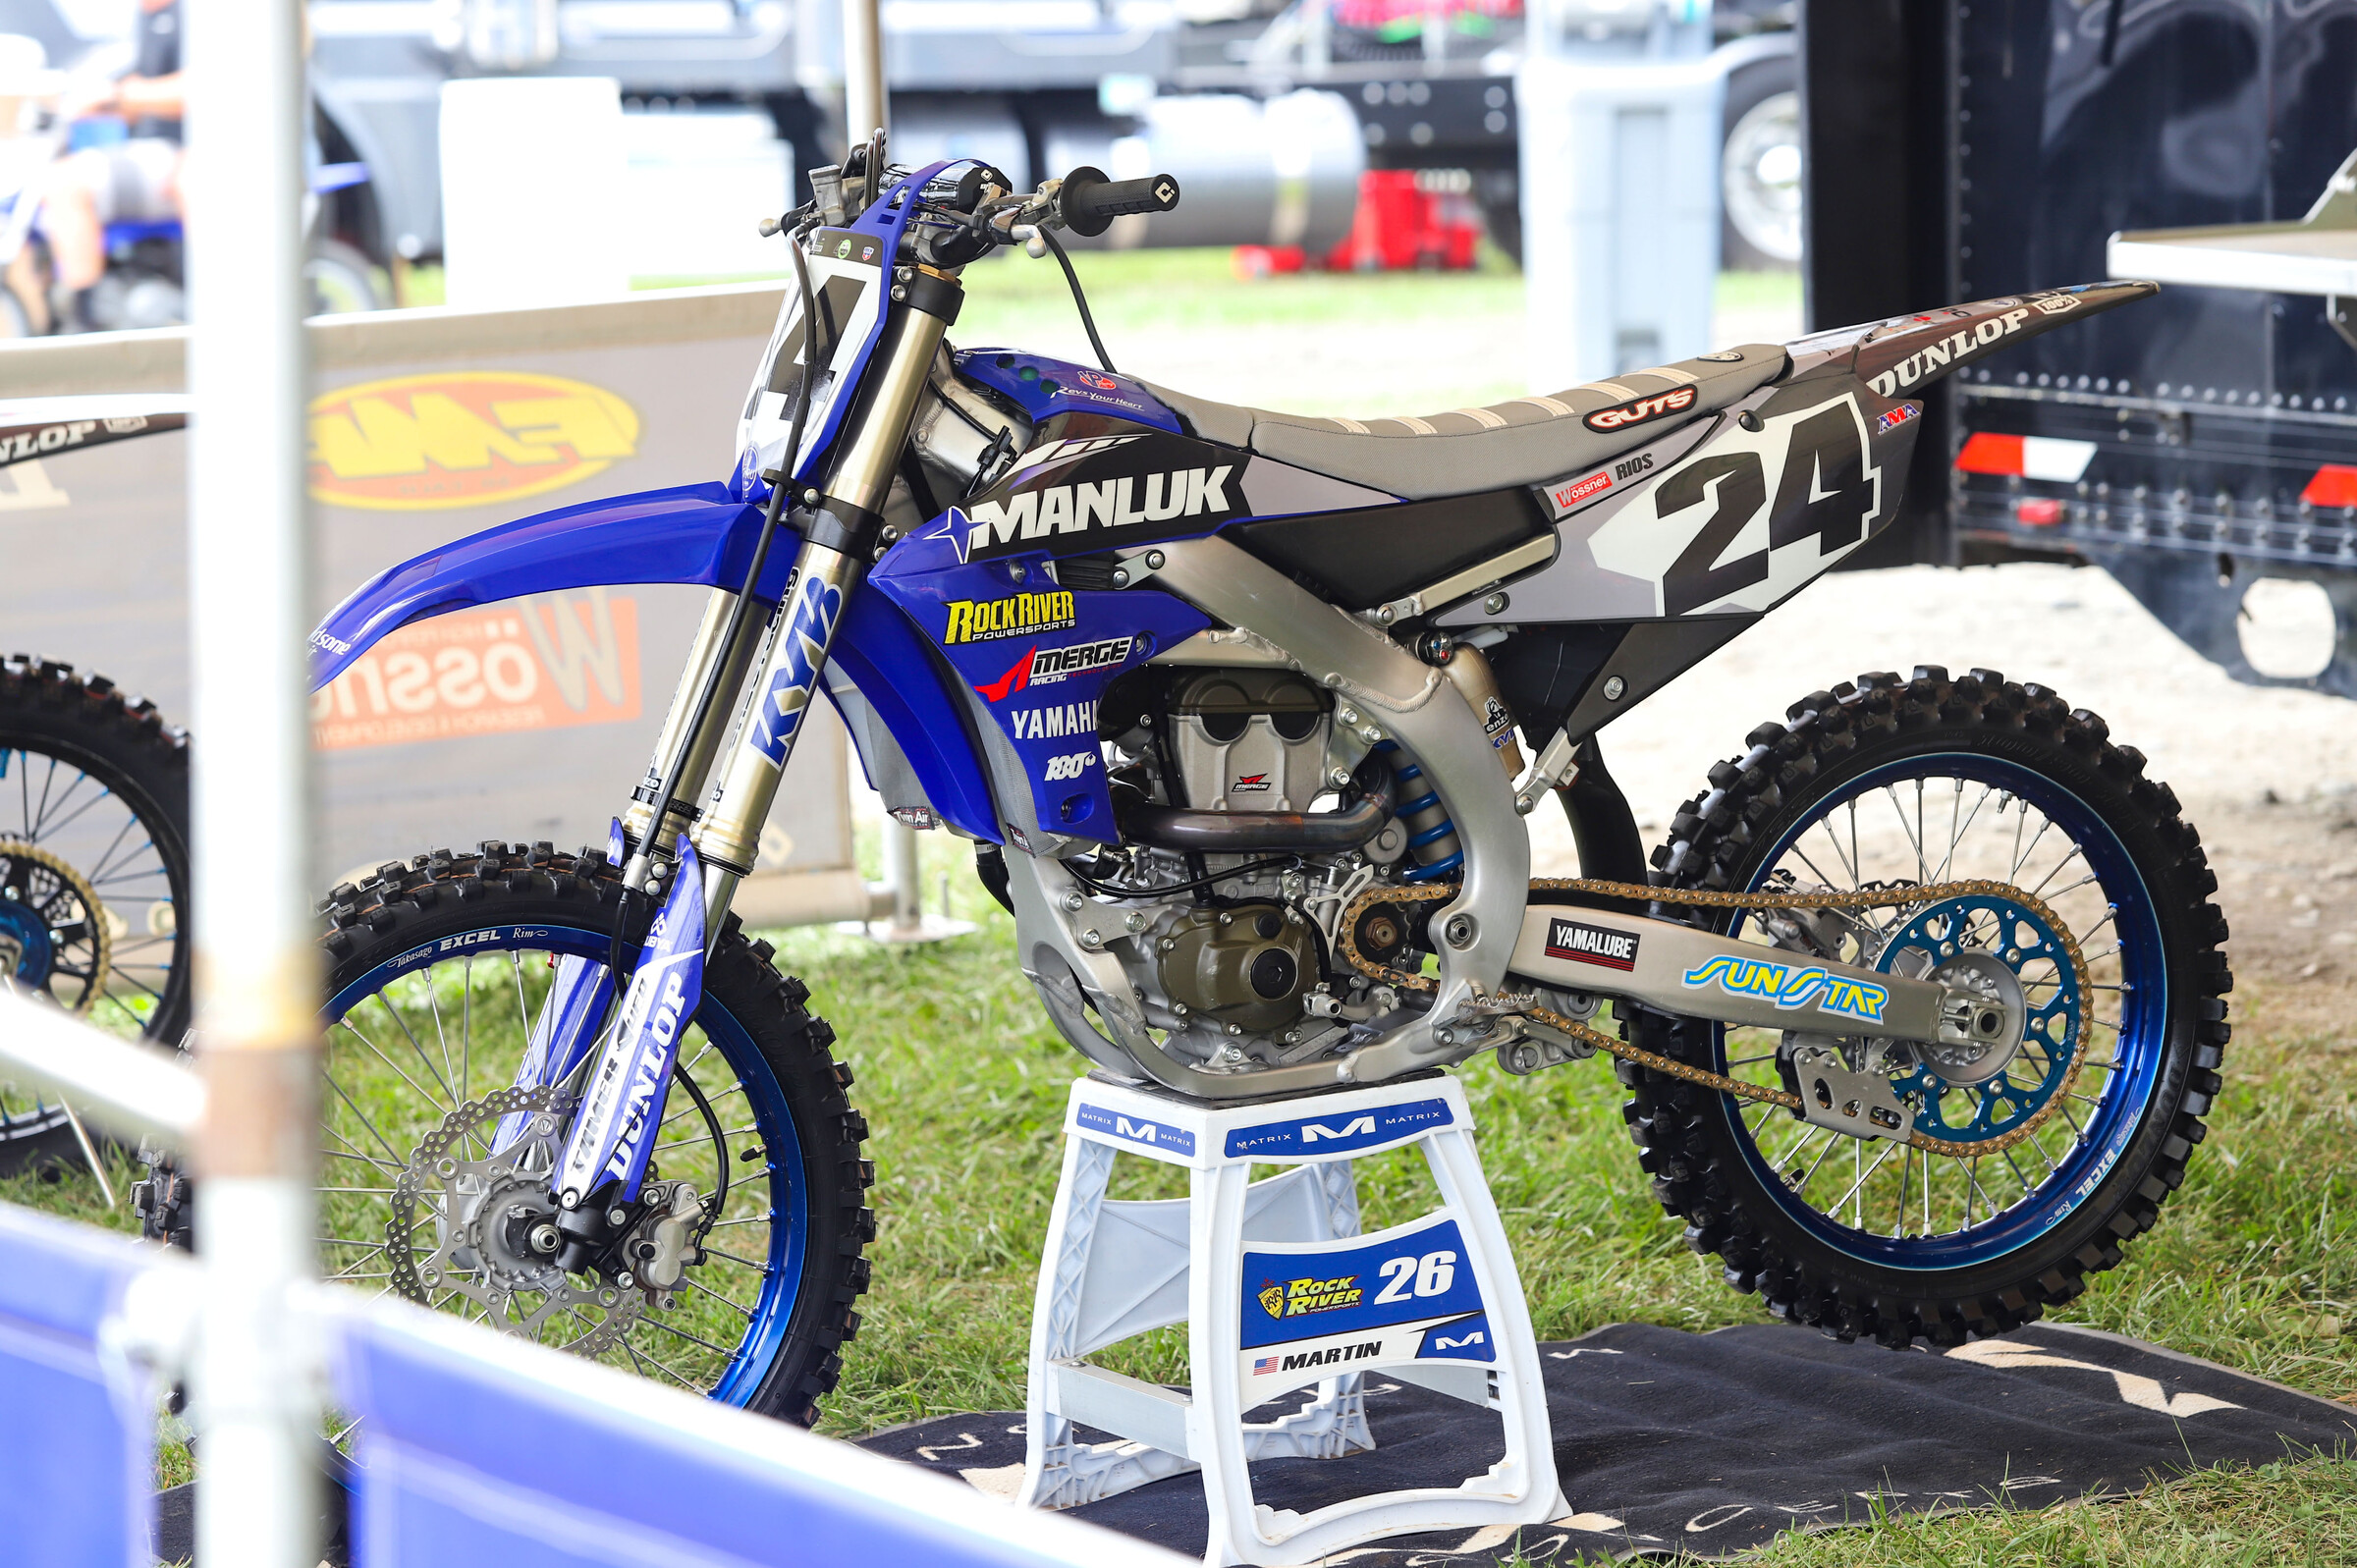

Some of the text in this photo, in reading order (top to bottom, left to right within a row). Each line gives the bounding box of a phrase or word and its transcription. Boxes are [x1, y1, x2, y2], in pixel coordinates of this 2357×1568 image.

[2042, 295, 2073, 311] 100%
[1866, 308, 2029, 398] DUNLOP
[1050, 386, 1144, 410] Revs Your Heart
[1590, 388, 1694, 428] GUTS
[1878, 403, 1920, 434] AMA
[1616, 453, 1654, 481] RIOS
[970, 464, 1233, 550] MANLUK
[1560, 475, 1608, 507] Wössner
[1655, 401, 1874, 617] 24
[308, 628, 352, 656] dsome
[972, 619, 1075, 641] POWERSPORTS
[750, 572, 844, 772] KYB
[1033, 639, 1131, 675] MERGE
[1030, 674, 1069, 686] RACING
[894, 810, 929, 825] Twin Air
[390, 928, 541, 968] Takasago EXCEL Rim
[644, 935, 672, 952] UBYA
[1556, 925, 1633, 959] YAMALUBE
[1687, 957, 1888, 1019] SUNSTAR
[606, 972, 685, 1181] DUNLOP
[1081, 1112, 1112, 1125] MATRIX
[1160, 1133, 1191, 1147] MATRIX
[1236, 1134, 1291, 1148] MATRIX
[1386, 1111, 1441, 1125] MATRIX
[2075, 1148, 2116, 1197] EXCEL
[1287, 1275, 1356, 1298] ROCK
[1374, 1250, 1456, 1305] 26
[1285, 1288, 1362, 1316] RIVER
[1282, 1341, 1383, 1372] MARTIN
